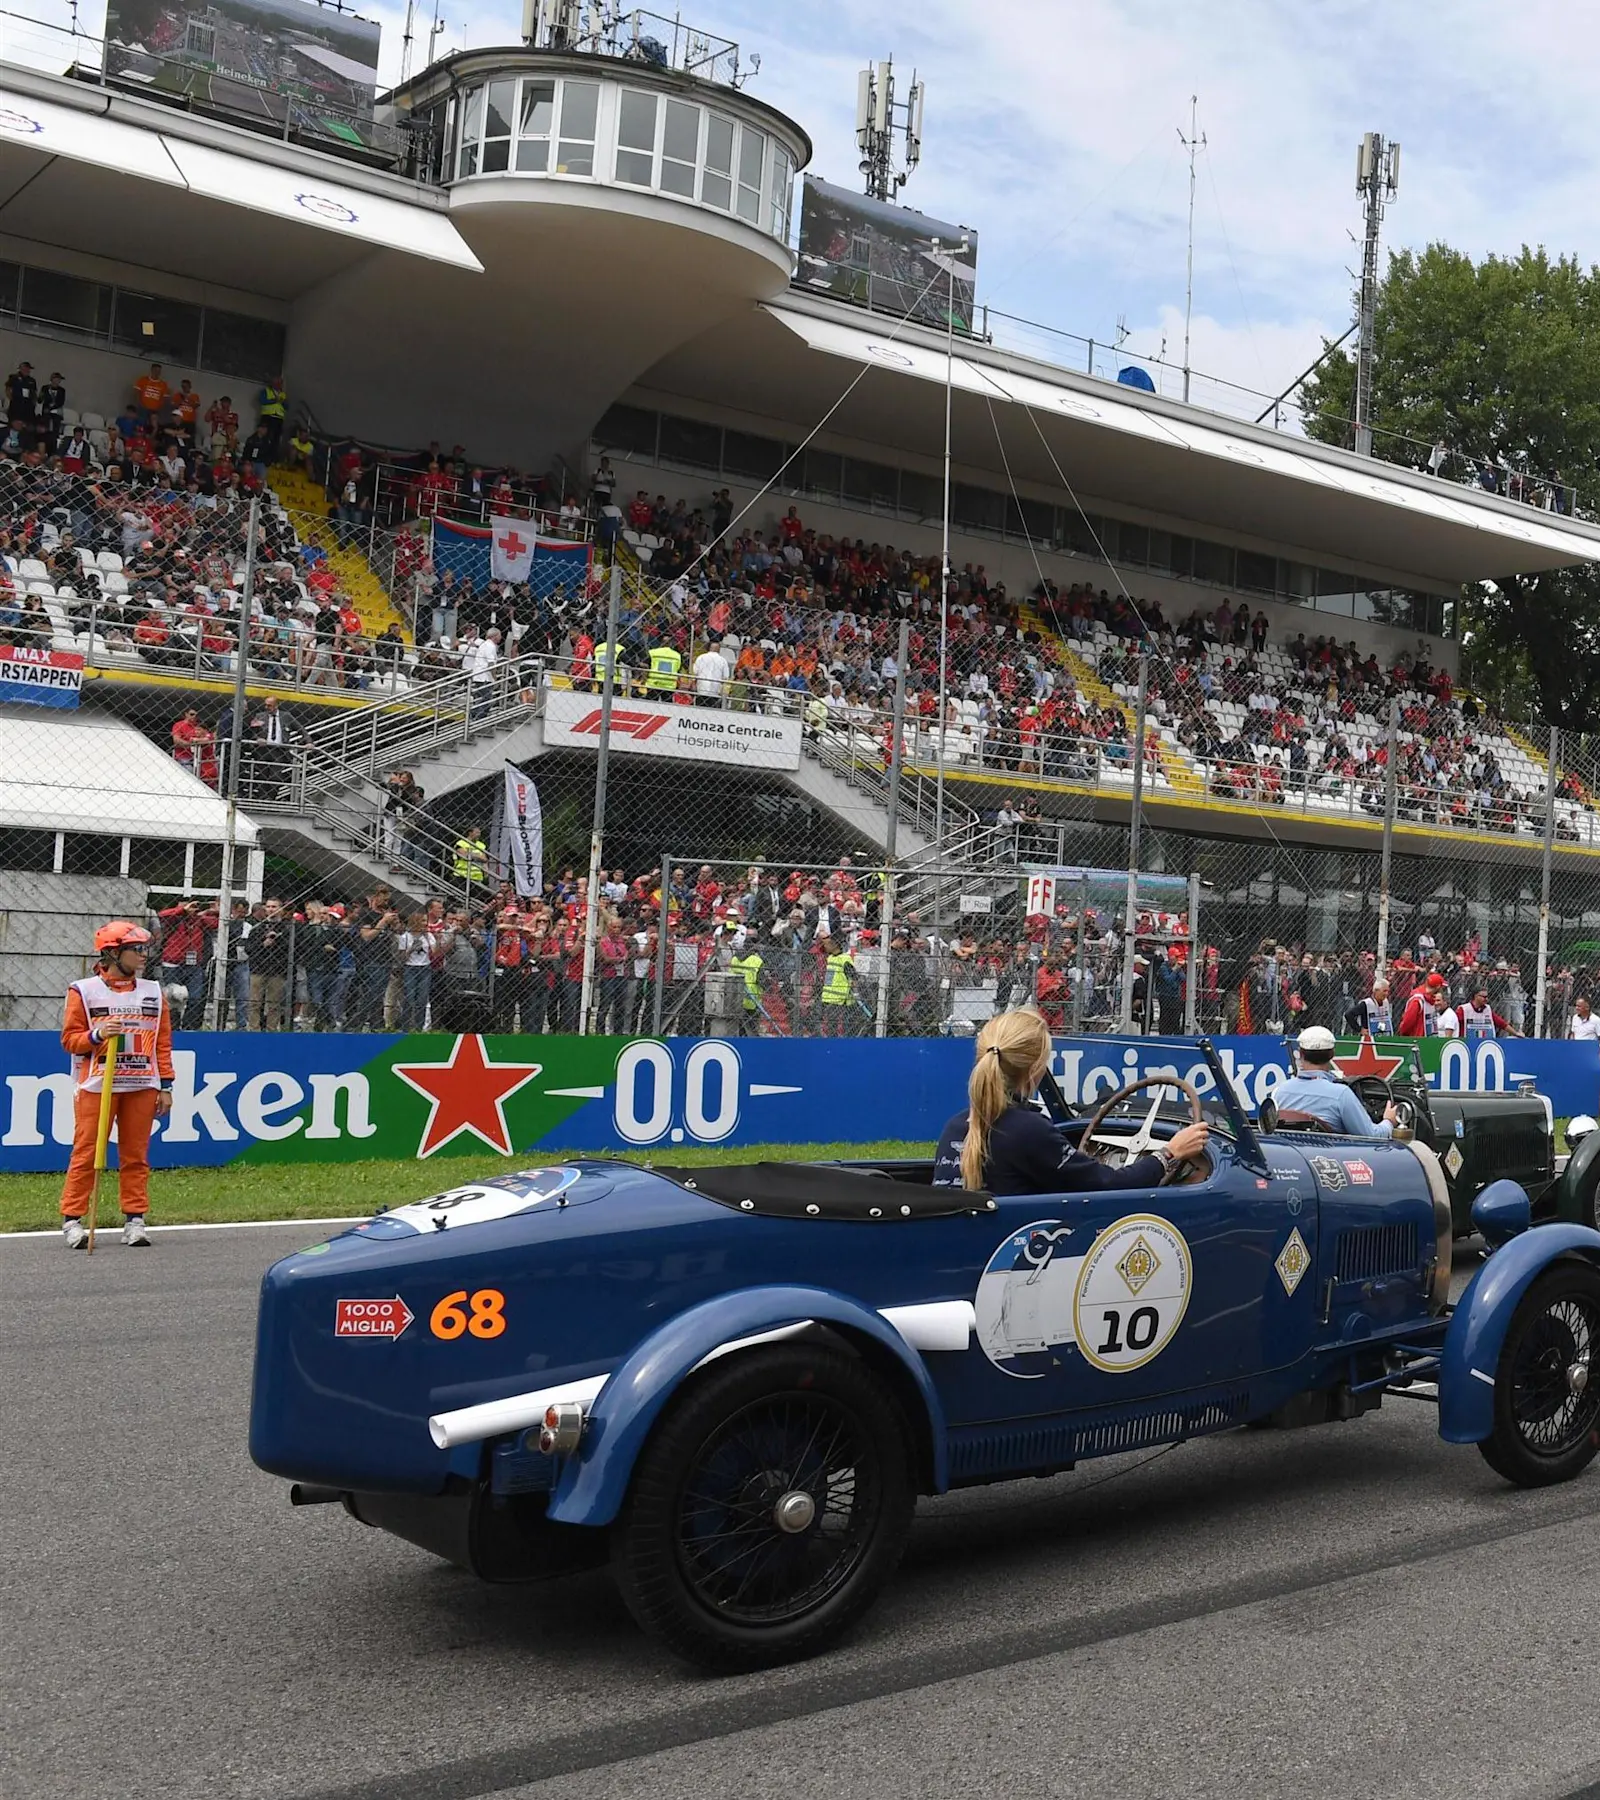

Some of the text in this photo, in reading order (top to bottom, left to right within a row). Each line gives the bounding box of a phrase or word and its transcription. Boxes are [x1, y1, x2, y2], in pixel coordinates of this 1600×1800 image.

[216, 63, 268, 88] Heineken
[13, 646, 52, 665] MAX
[678, 718, 724, 733] Monza
[727, 724, 783, 740] Centrale
[677, 732, 749, 754] Hospitality
[612, 1039, 742, 1144] 0.0
[344, 1304, 394, 1317] 1000
[429, 1289, 507, 1341] 68
[339, 1320, 396, 1333] MIGLIA
[1098, 1307, 1159, 1354] 10
